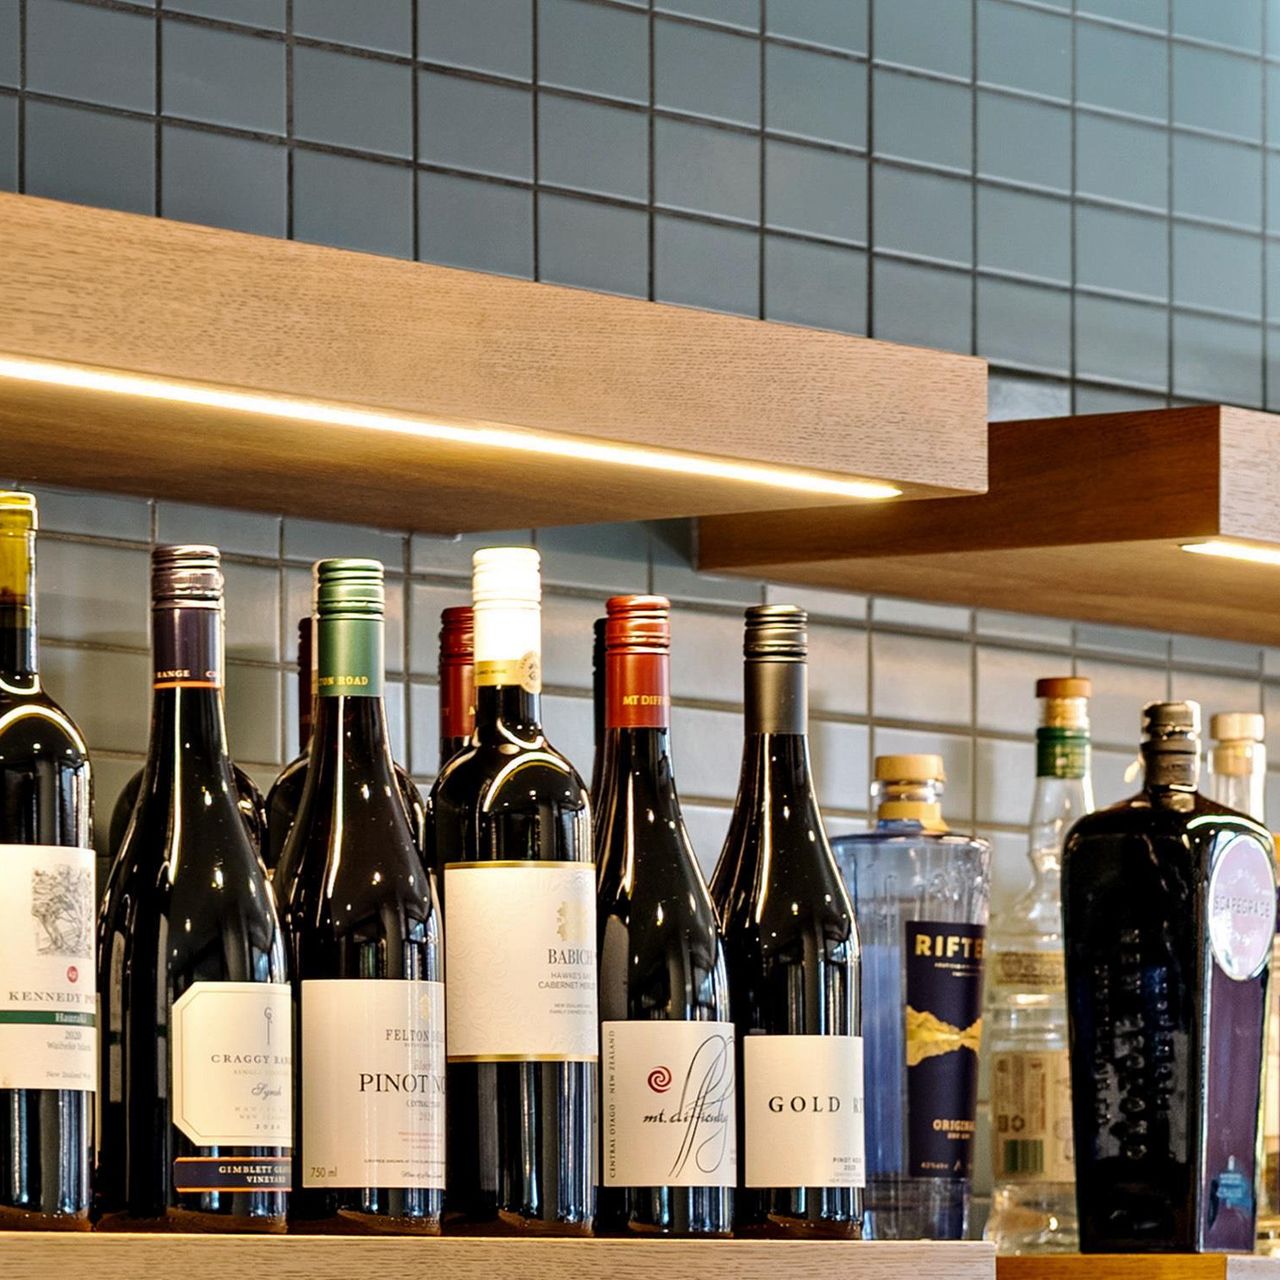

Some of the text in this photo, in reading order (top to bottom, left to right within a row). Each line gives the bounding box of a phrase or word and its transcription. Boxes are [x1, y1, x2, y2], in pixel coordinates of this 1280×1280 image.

[337, 675, 369, 686] ROAD
[8, 991, 81, 1004] KENNEDY
[385, 1029, 429, 1042] FELTON
[210, 1054, 271, 1065] CRAGGY
[358, 1073, 430, 1093] PINOT
[608, 1074, 616, 1095] NEW
[768, 1095, 841, 1113] GOLD
[219, 1166, 273, 1174] GIMBLETT
[310, 1167, 326, 1178] 750
